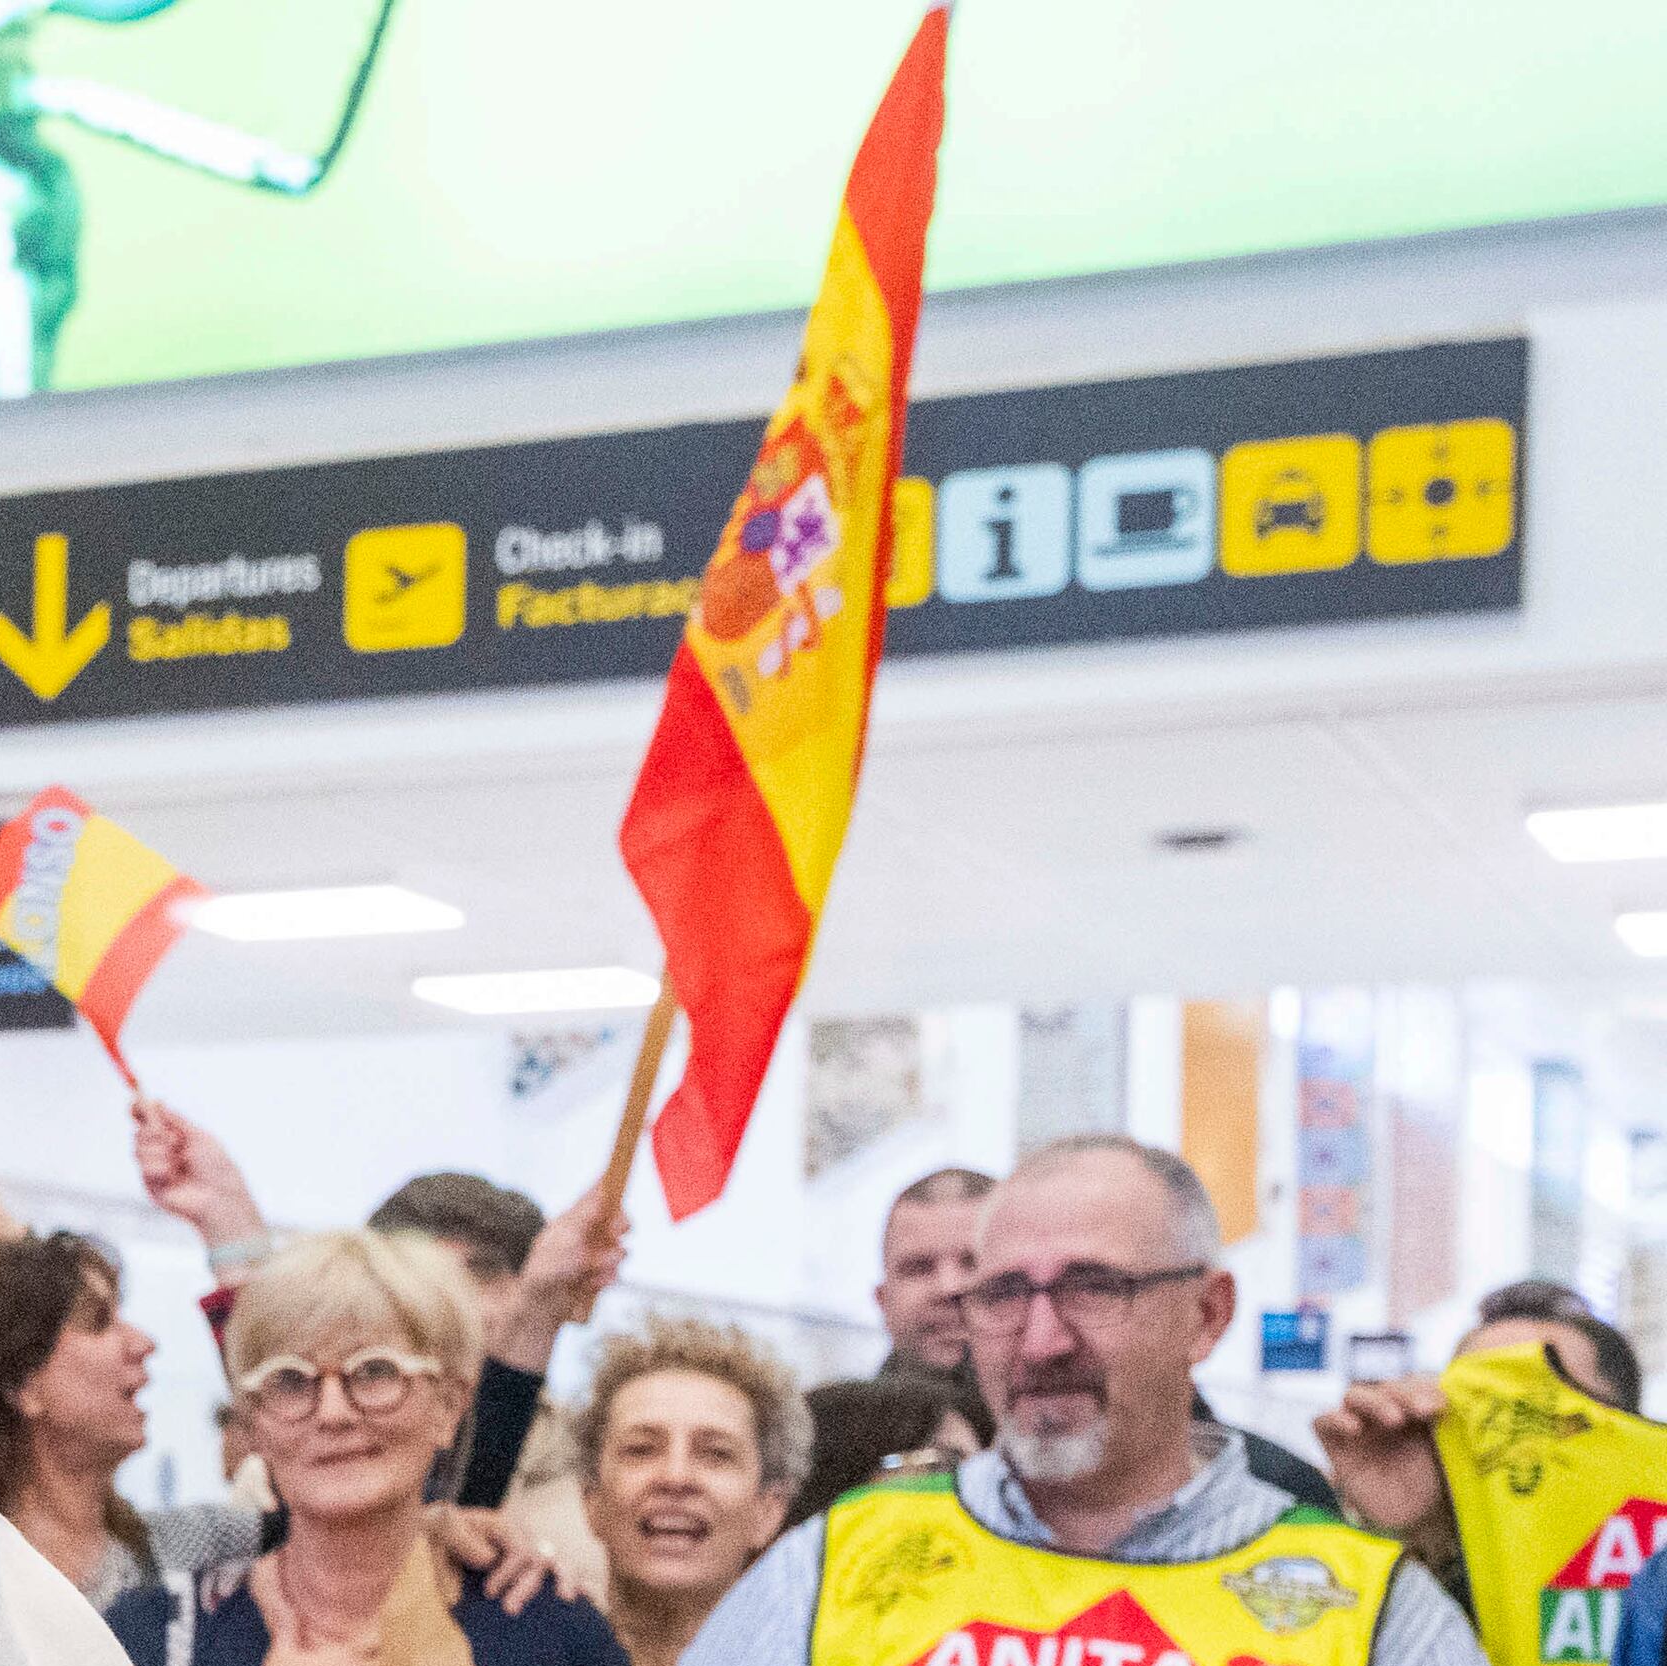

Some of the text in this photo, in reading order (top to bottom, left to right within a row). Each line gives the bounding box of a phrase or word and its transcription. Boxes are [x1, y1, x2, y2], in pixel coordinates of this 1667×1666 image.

[128, 516, 663, 607] Departures Check-in
[128, 579, 703, 661] Salidas Facturac
